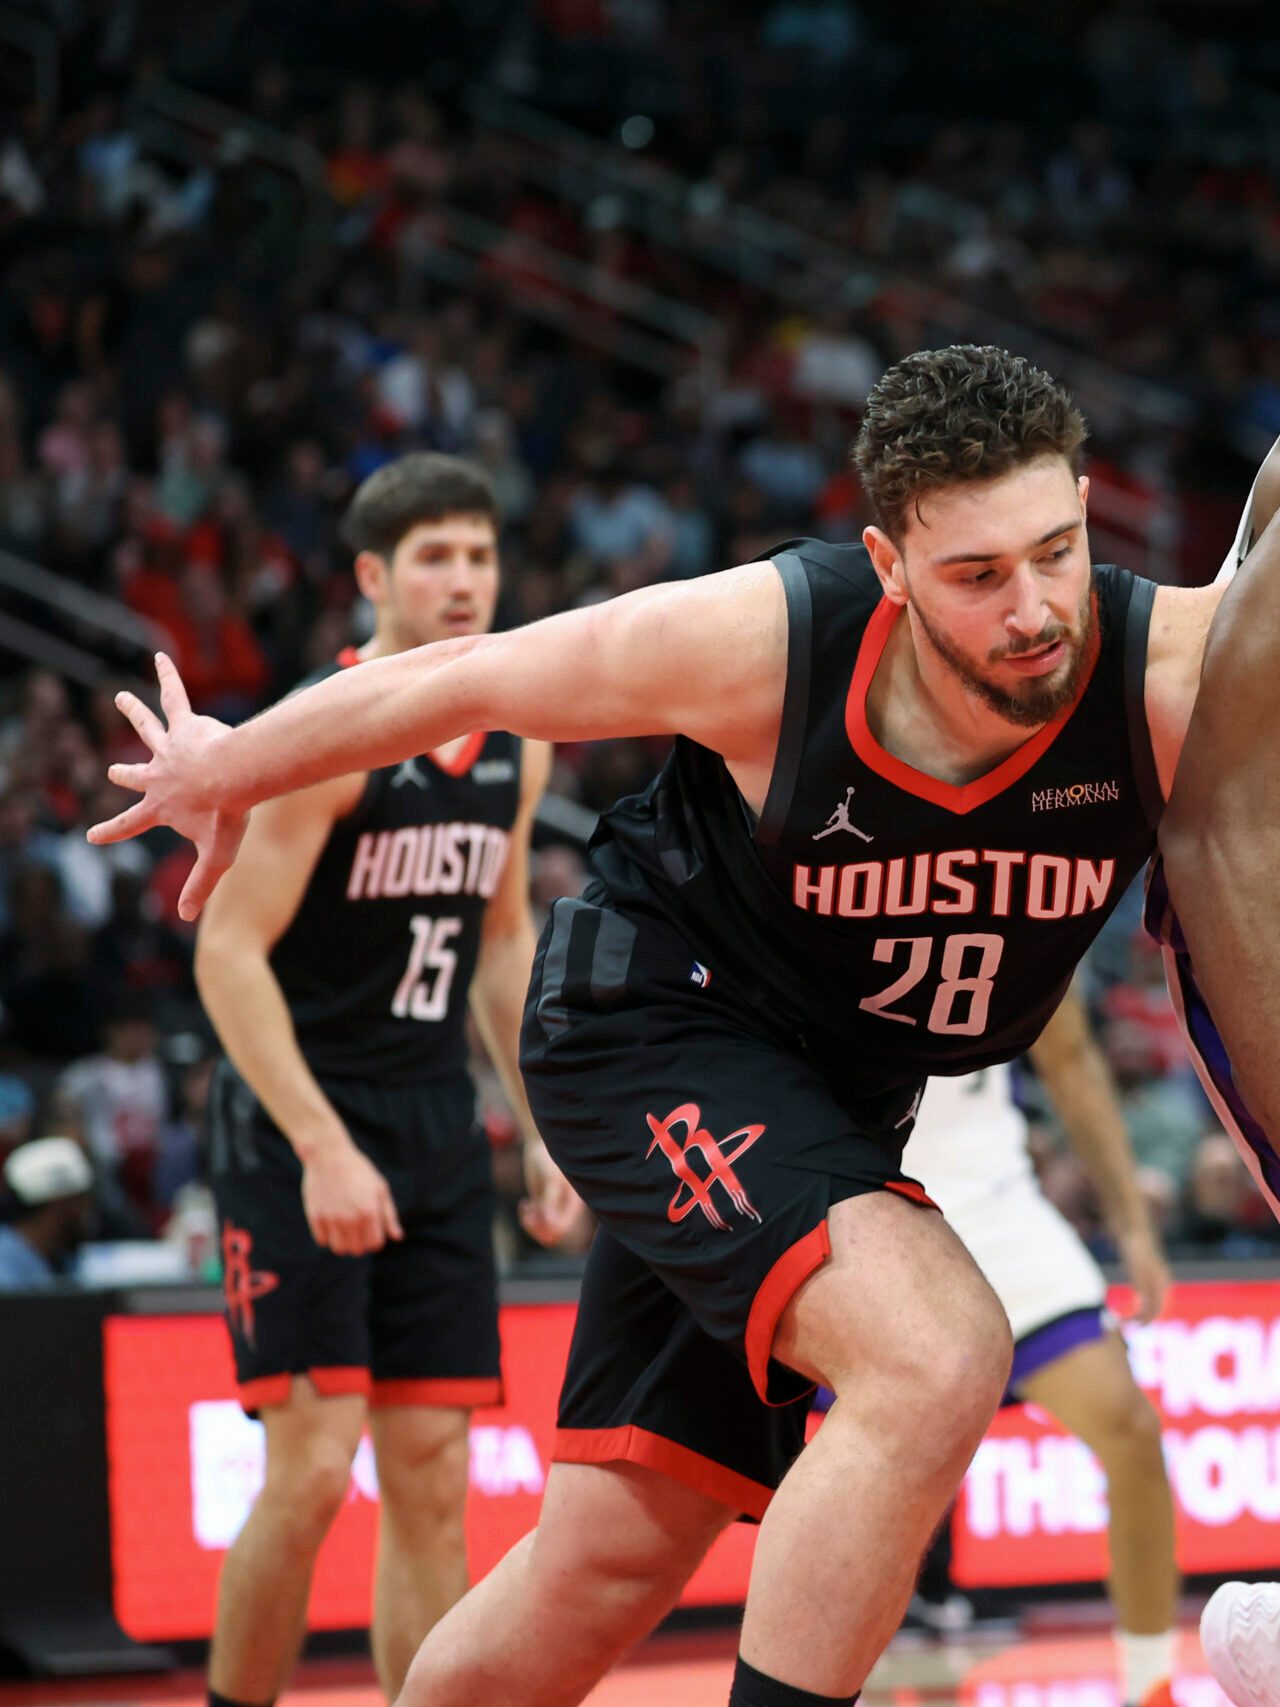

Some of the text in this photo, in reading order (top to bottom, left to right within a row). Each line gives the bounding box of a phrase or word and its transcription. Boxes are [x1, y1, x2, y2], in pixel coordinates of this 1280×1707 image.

[1032, 781, 1119, 802] MEMORIAL
[1032, 788, 1119, 812] HERMANN
[793, 848, 1116, 920] HOUSTON
[390, 914, 463, 1022] 15
[858, 932, 1005, 1037] 28
